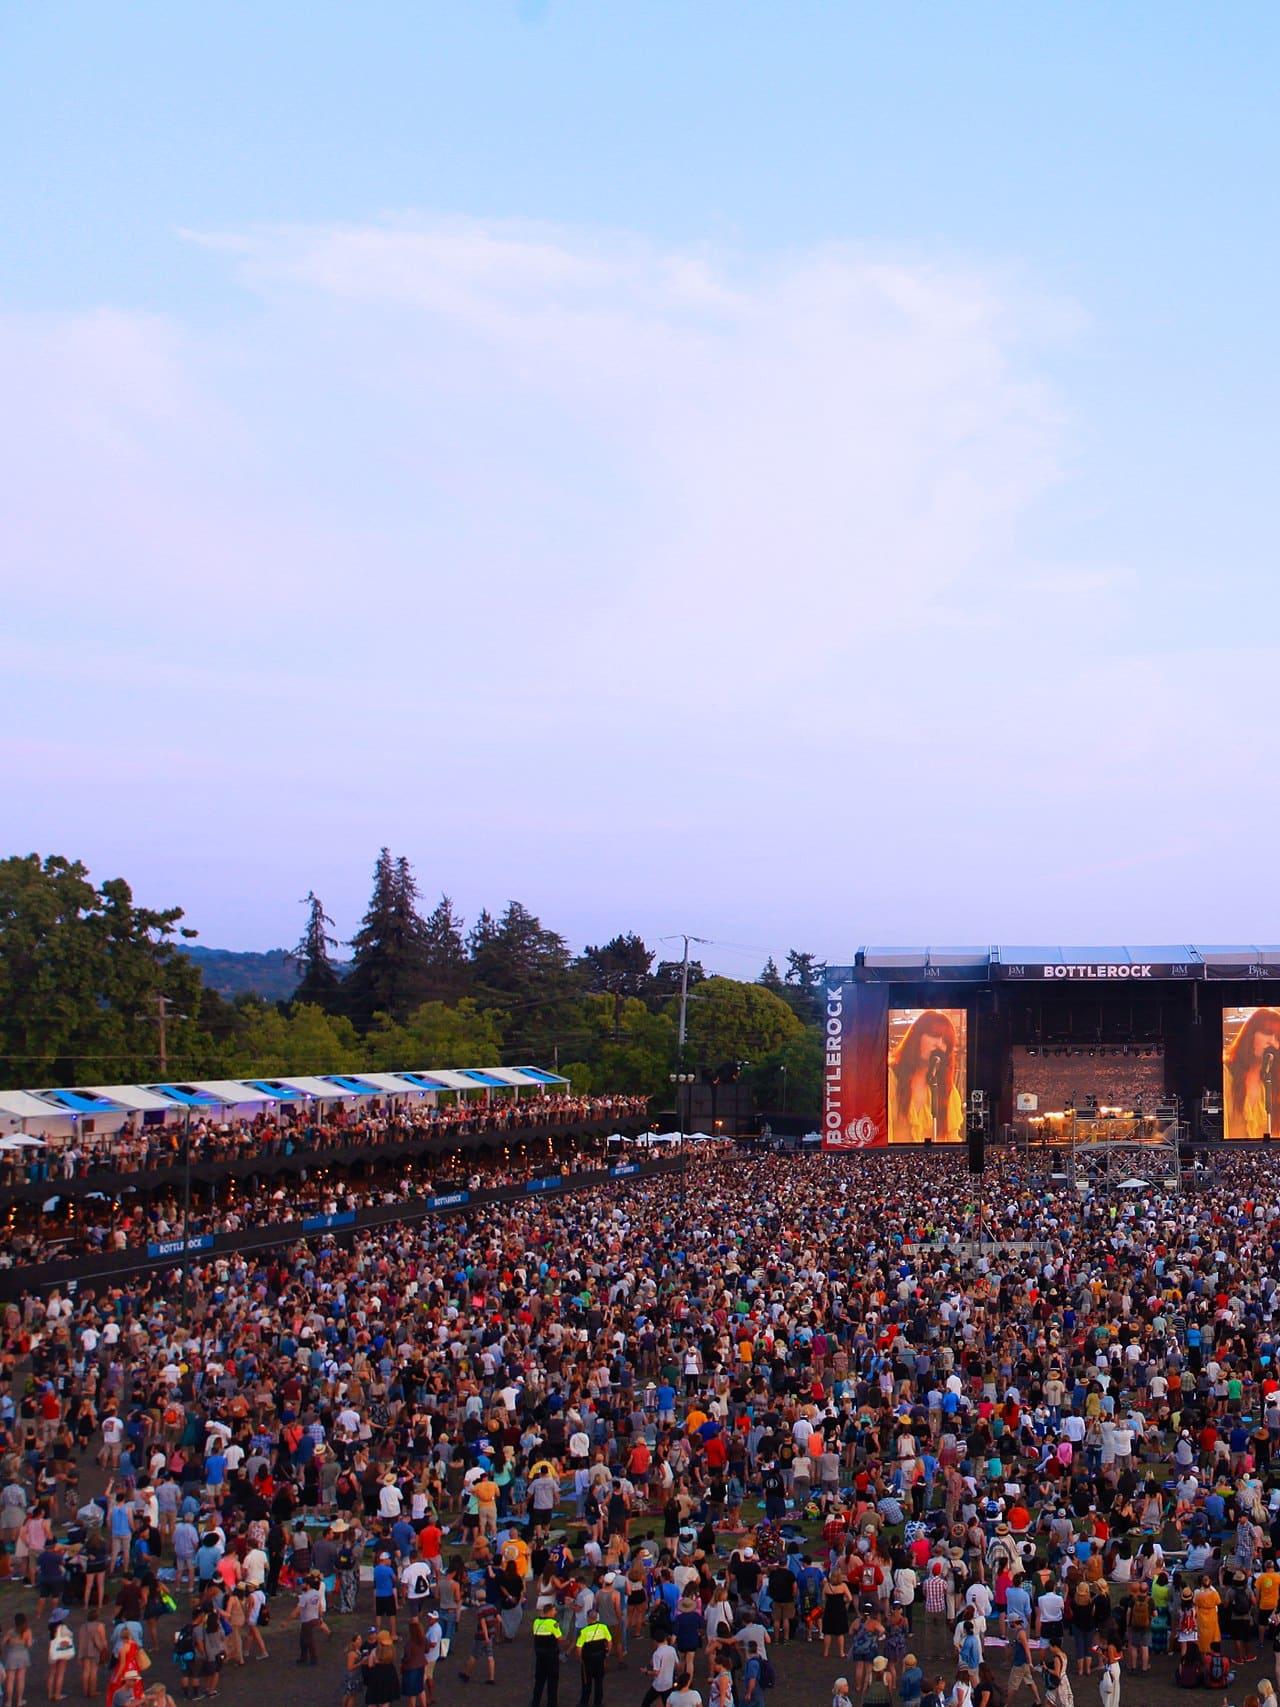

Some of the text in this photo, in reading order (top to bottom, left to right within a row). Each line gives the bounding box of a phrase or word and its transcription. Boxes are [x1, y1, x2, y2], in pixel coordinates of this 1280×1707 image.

[1043, 965, 1152, 978] BOTTLEROCK
[826, 986, 843, 1144] BOTTLEROCK
[159, 1238, 202, 1254] BOTTLEOCK
